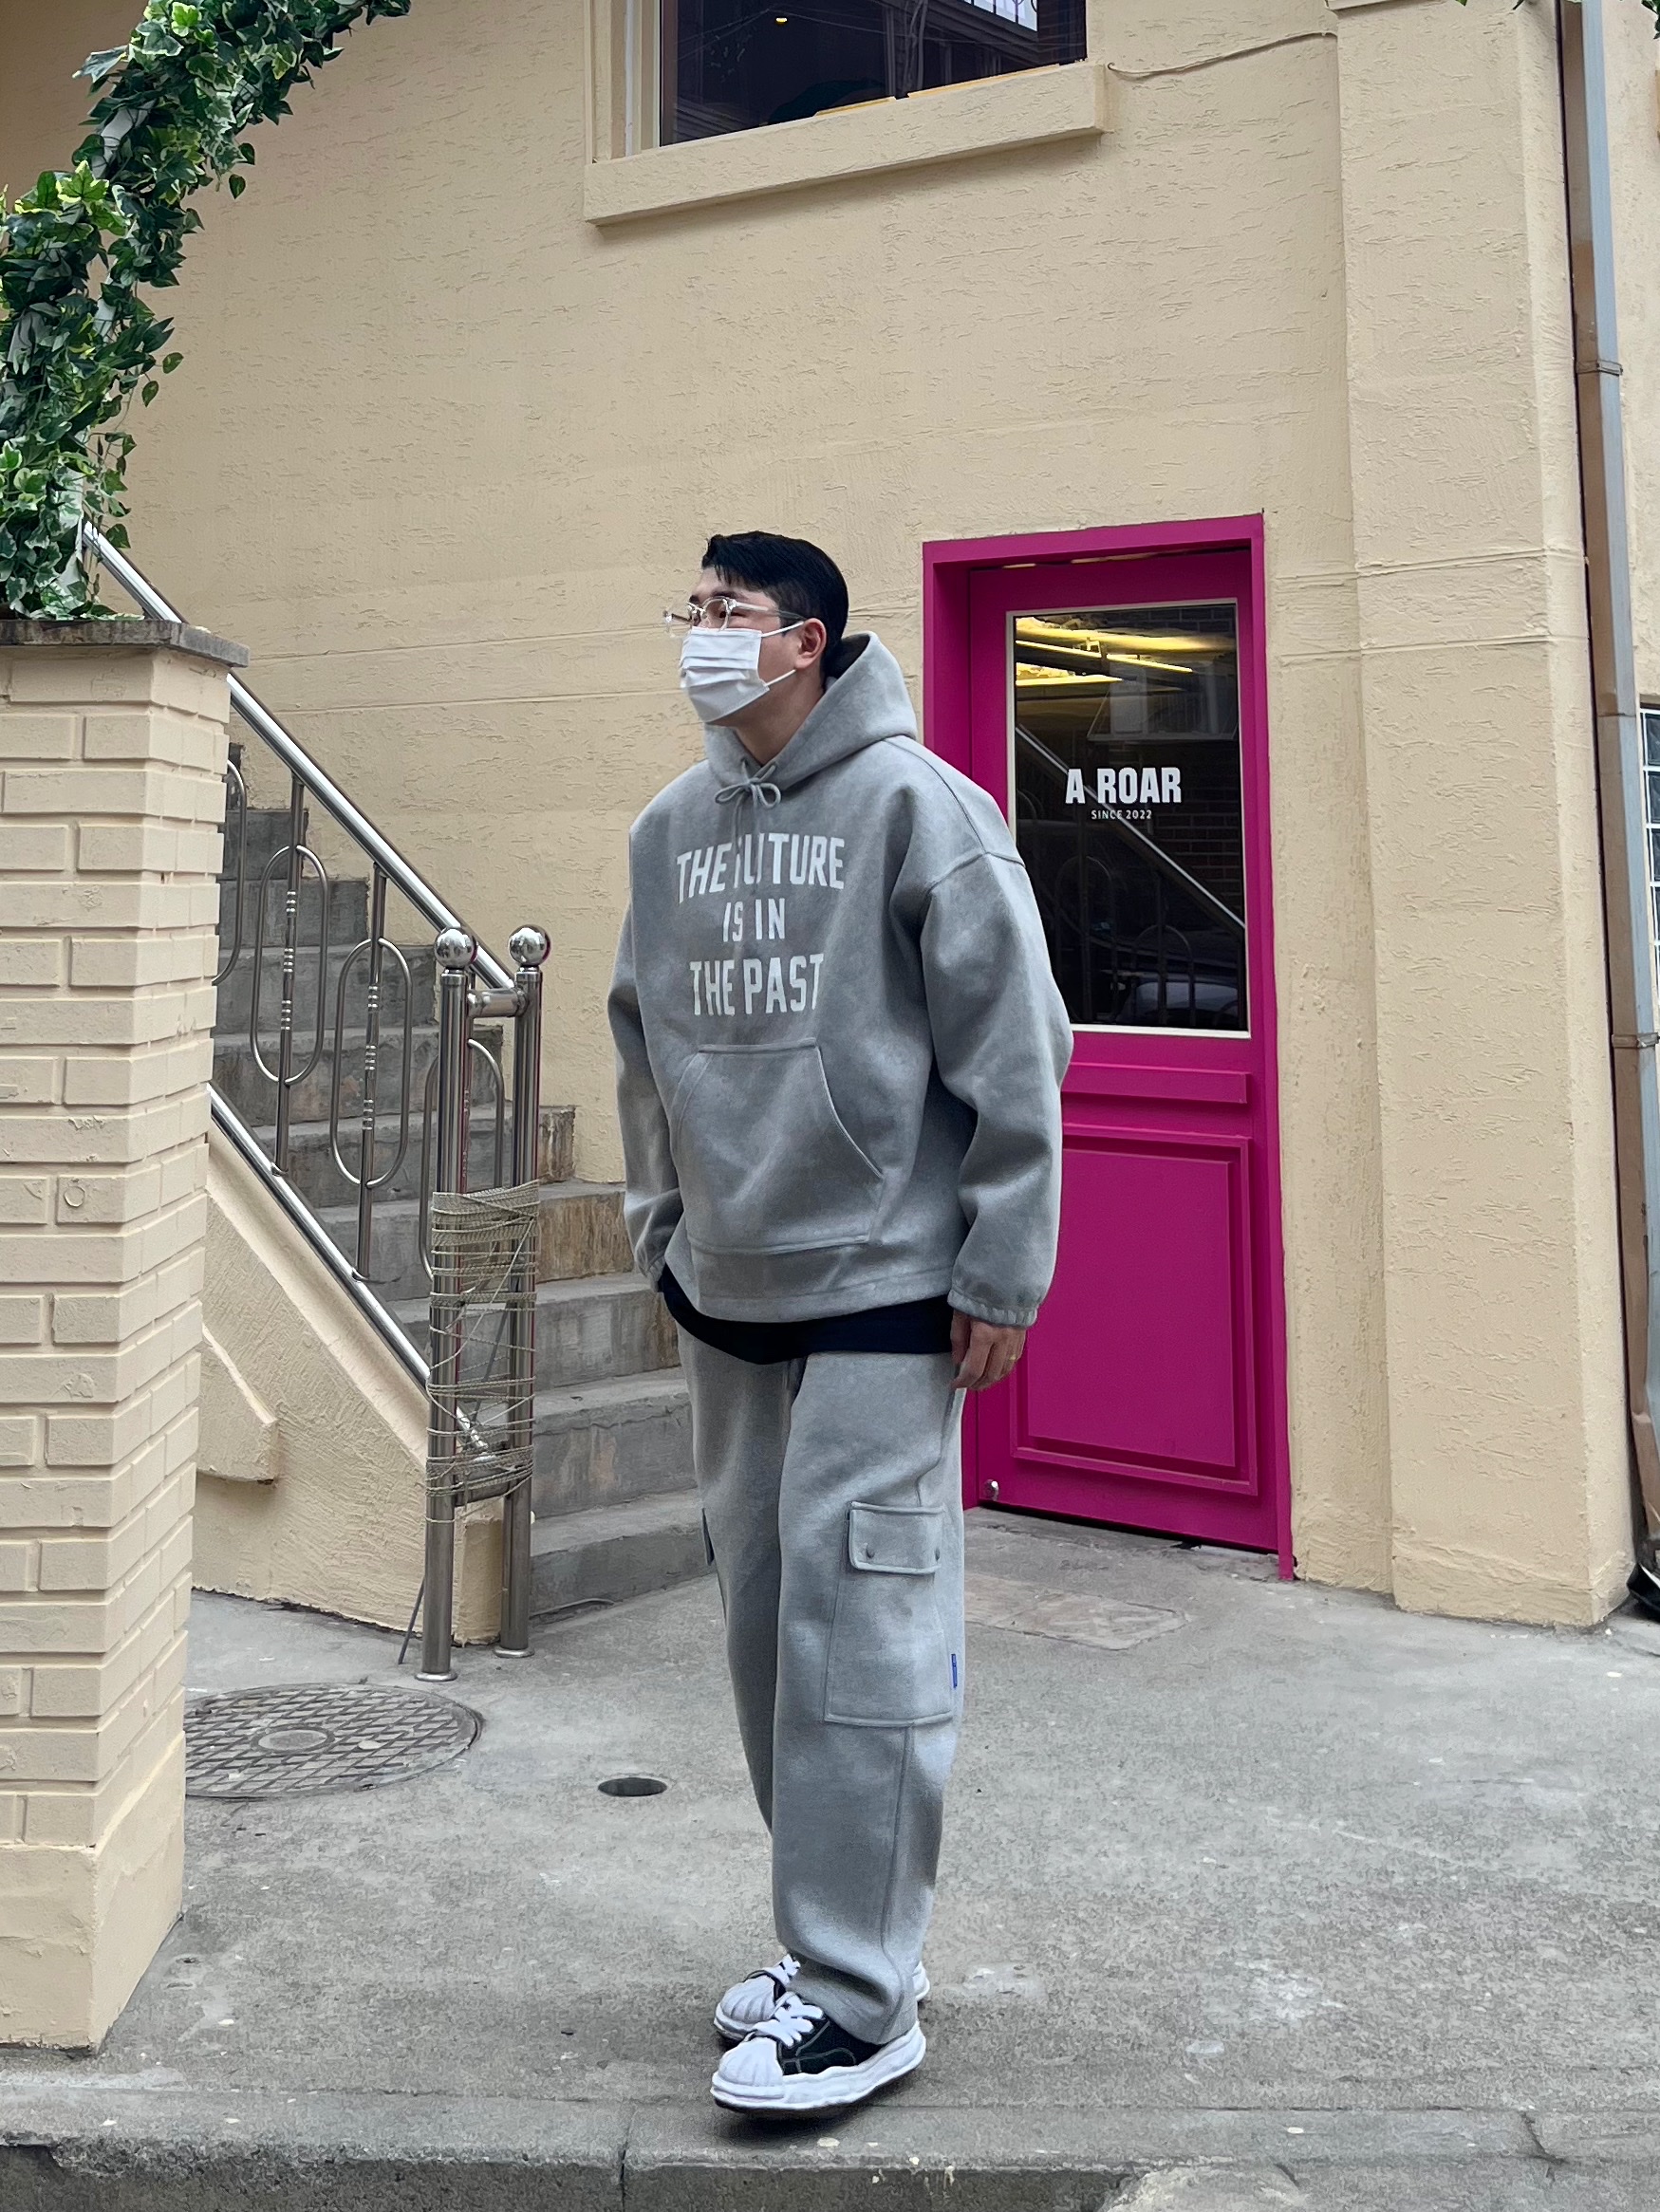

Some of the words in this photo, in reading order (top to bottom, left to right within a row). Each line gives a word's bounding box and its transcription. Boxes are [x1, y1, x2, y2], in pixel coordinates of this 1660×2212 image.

[1065, 769, 1086, 804] A
[1096, 767, 1182, 804] ROAR
[1091, 809, 1123, 820] SINCE
[1126, 809, 1152, 820] 2022
[677, 843, 733, 904] THE
[722, 902, 743, 942] IS
[755, 898, 786, 939] IN
[689, 959, 736, 1015] THE
[742, 953, 824, 1014] PAST
